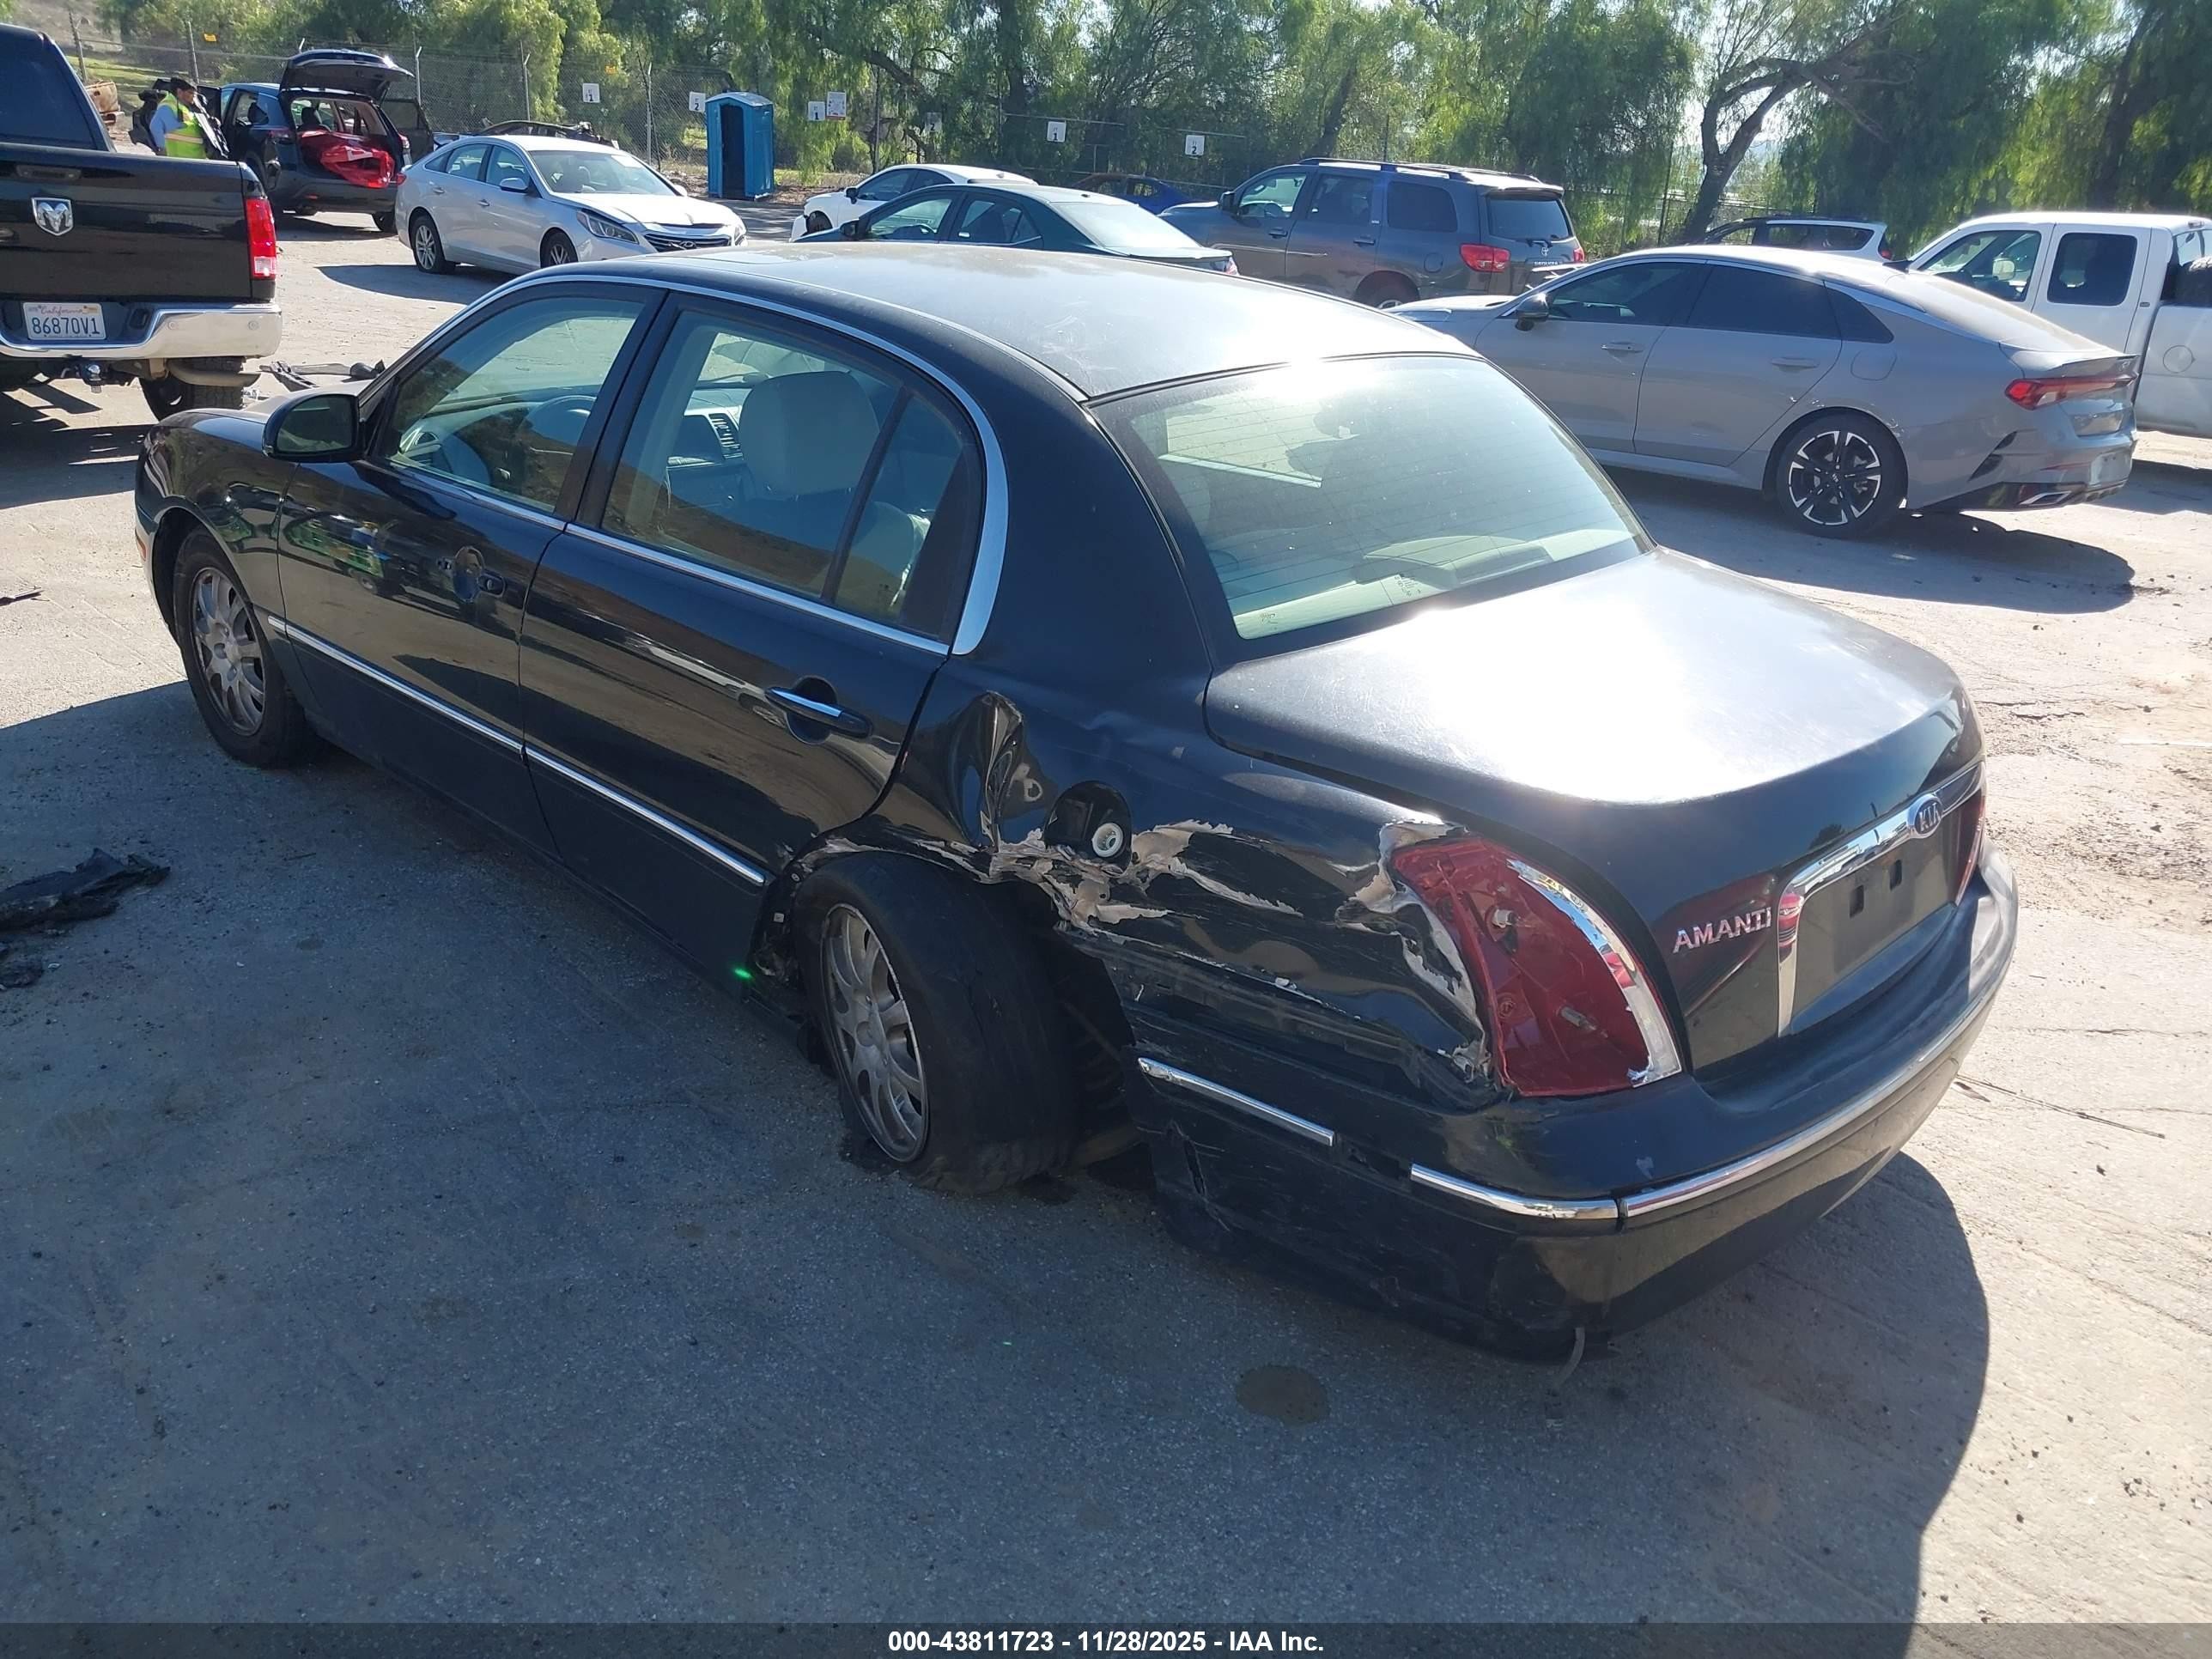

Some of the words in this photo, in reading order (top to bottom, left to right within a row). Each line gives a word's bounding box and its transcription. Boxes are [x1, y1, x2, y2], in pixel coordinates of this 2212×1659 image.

[40, 305, 83, 316] California
[32, 317, 100, 335] 86870V1
[1918, 802, 1942, 832] KIA
[1673, 907, 1771, 954] AMANTI
